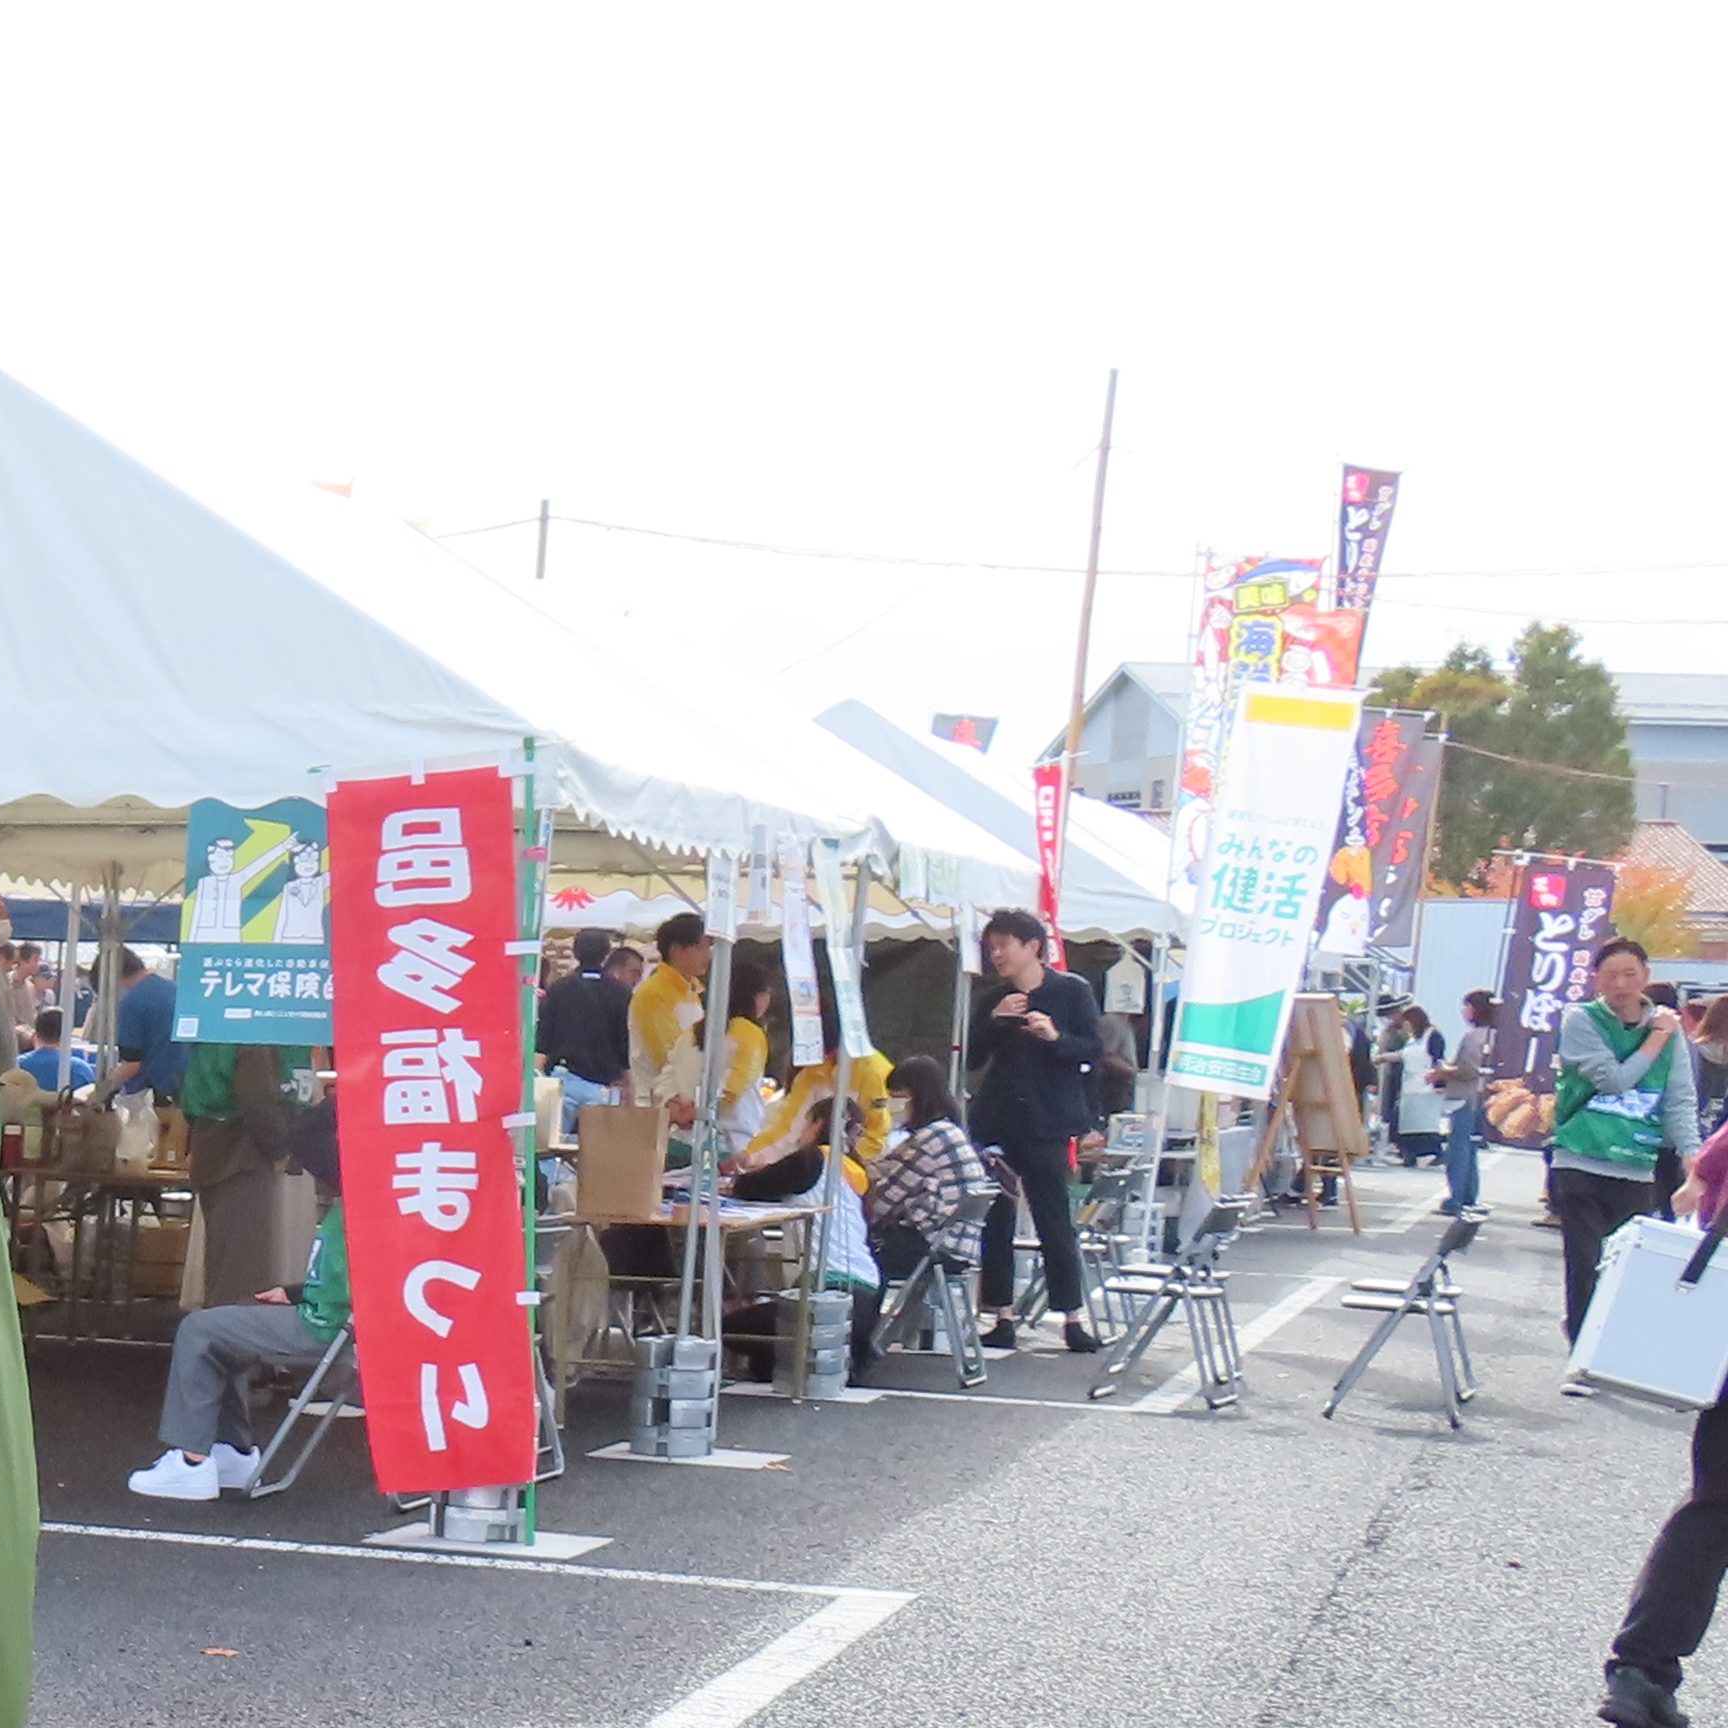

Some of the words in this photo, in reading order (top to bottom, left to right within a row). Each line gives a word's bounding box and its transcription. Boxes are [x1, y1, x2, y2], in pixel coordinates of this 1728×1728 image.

[1216, 832, 1320, 866] みんなの
[1209, 862, 1309, 921] 健活
[1198, 911, 1296, 949] プロジェクト
[1520, 911, 1576, 1073] とりぼー
